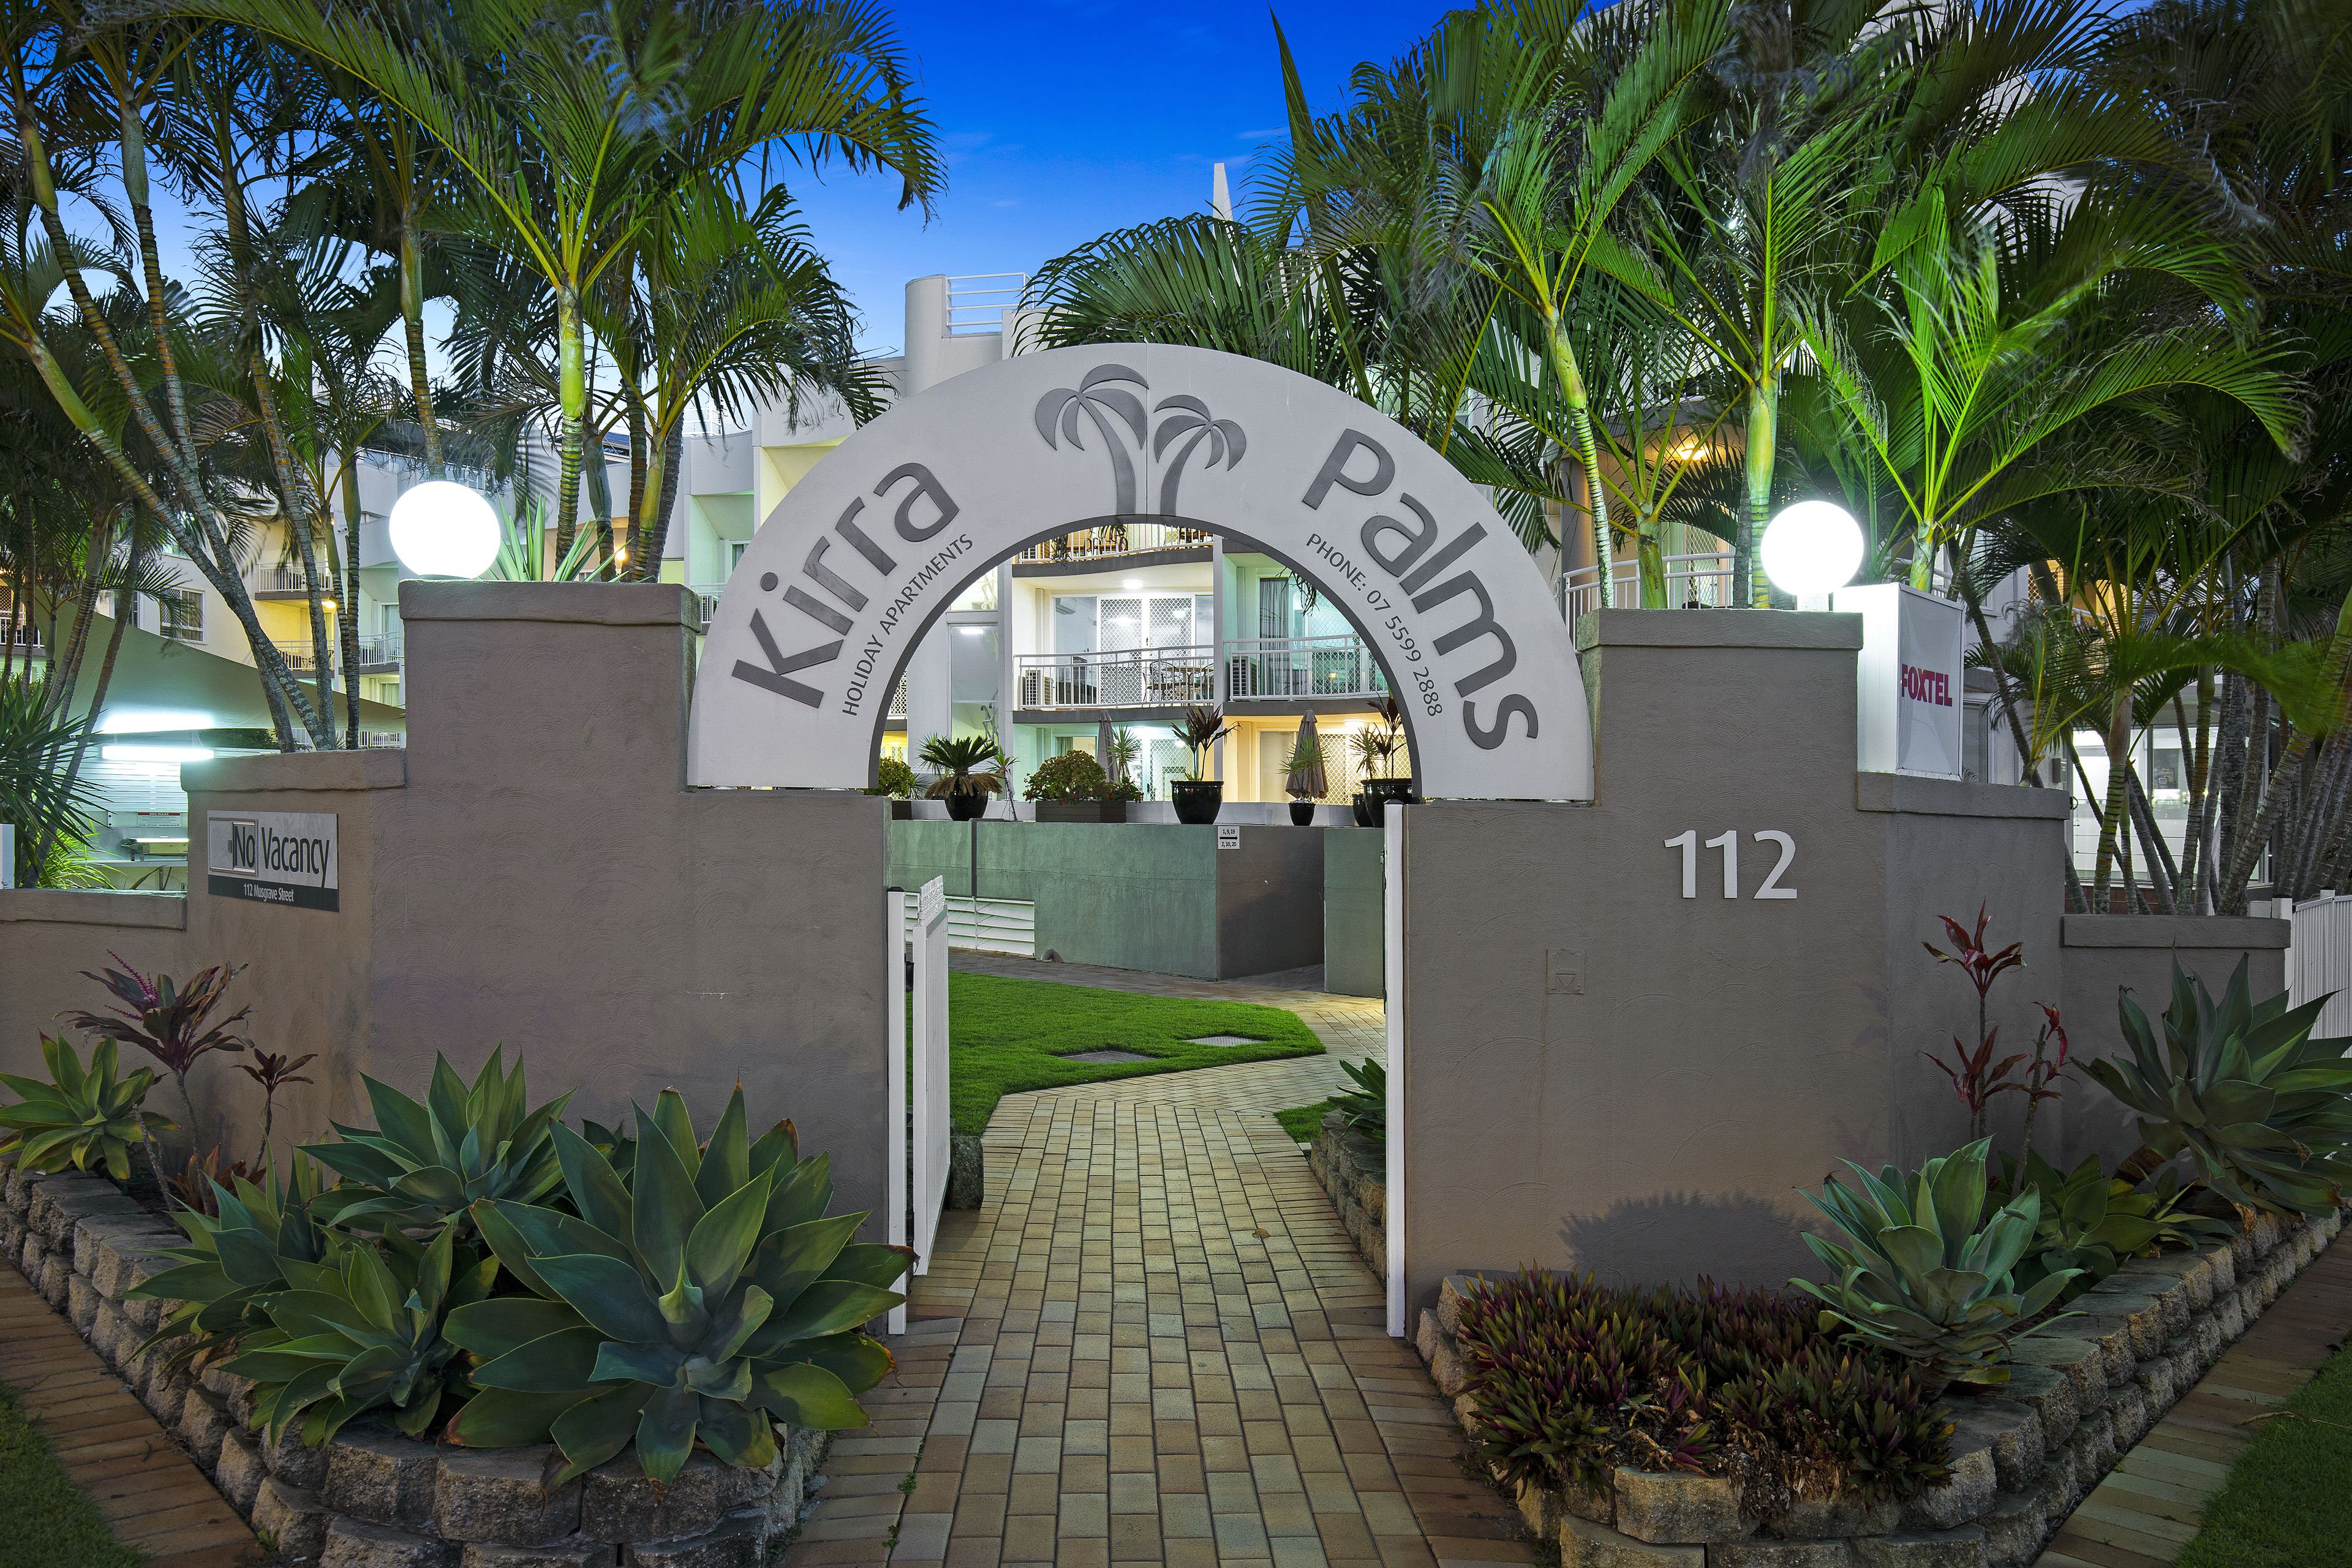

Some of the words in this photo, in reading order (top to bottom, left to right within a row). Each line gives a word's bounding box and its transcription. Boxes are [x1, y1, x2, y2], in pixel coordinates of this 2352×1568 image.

[731, 462, 960, 709] Kirra
[1302, 428, 1539, 750] Palms
[842, 634, 884, 716] HOLIDAY
[880, 533, 973, 635] APARTMENTS
[1306, 533, 1366, 591] PHONE:
[1366, 590, 1391, 611] 07
[1385, 616, 1422, 662] 5599
[1412, 666, 1442, 717] 2888
[1901, 663, 1953, 707] FOXTEL
[235, 826, 255, 868] No
[261, 827, 330, 888] Vacancy
[1664, 830, 1797, 899] 112
[244, 883, 253, 897] 112
[254, 884, 277, 902] Musgrave
[278, 887, 294, 902] Street
